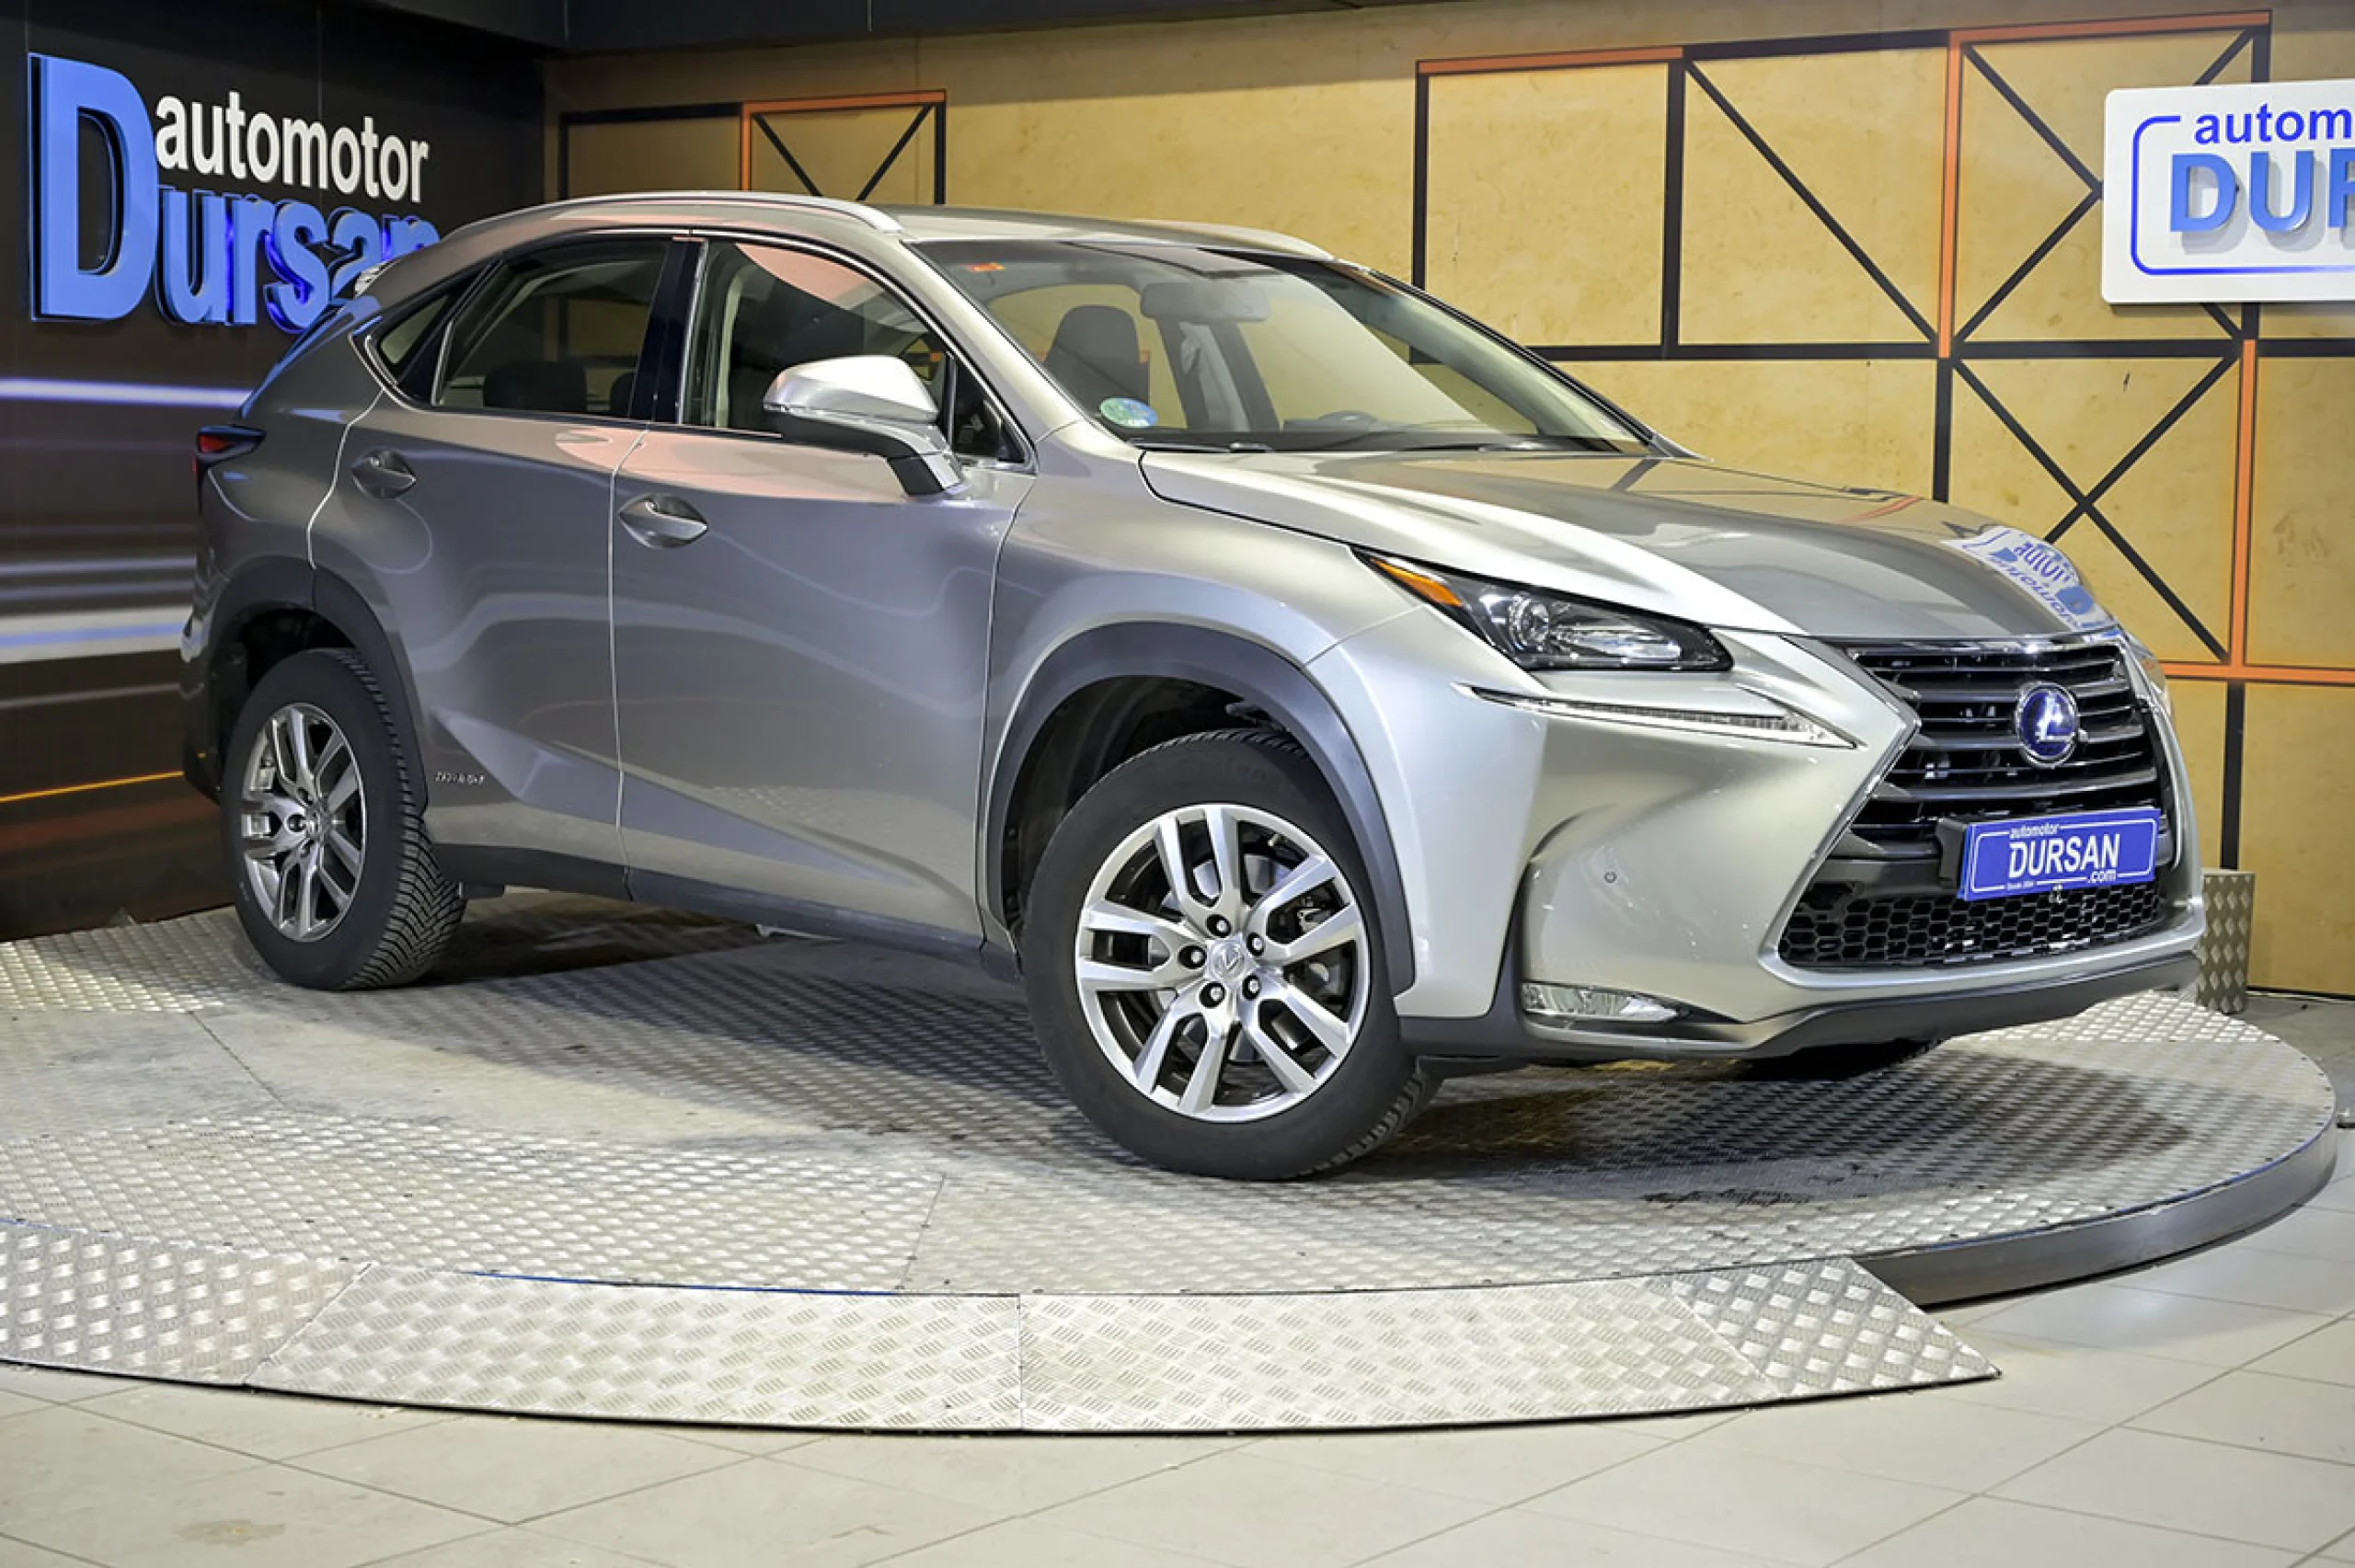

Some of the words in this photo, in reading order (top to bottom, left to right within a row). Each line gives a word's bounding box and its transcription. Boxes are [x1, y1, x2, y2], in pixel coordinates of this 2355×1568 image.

[2194, 102, 2352, 144] autom
[155, 91, 430, 202] automotor
[2008, 833, 2120, 879] DURSAN
